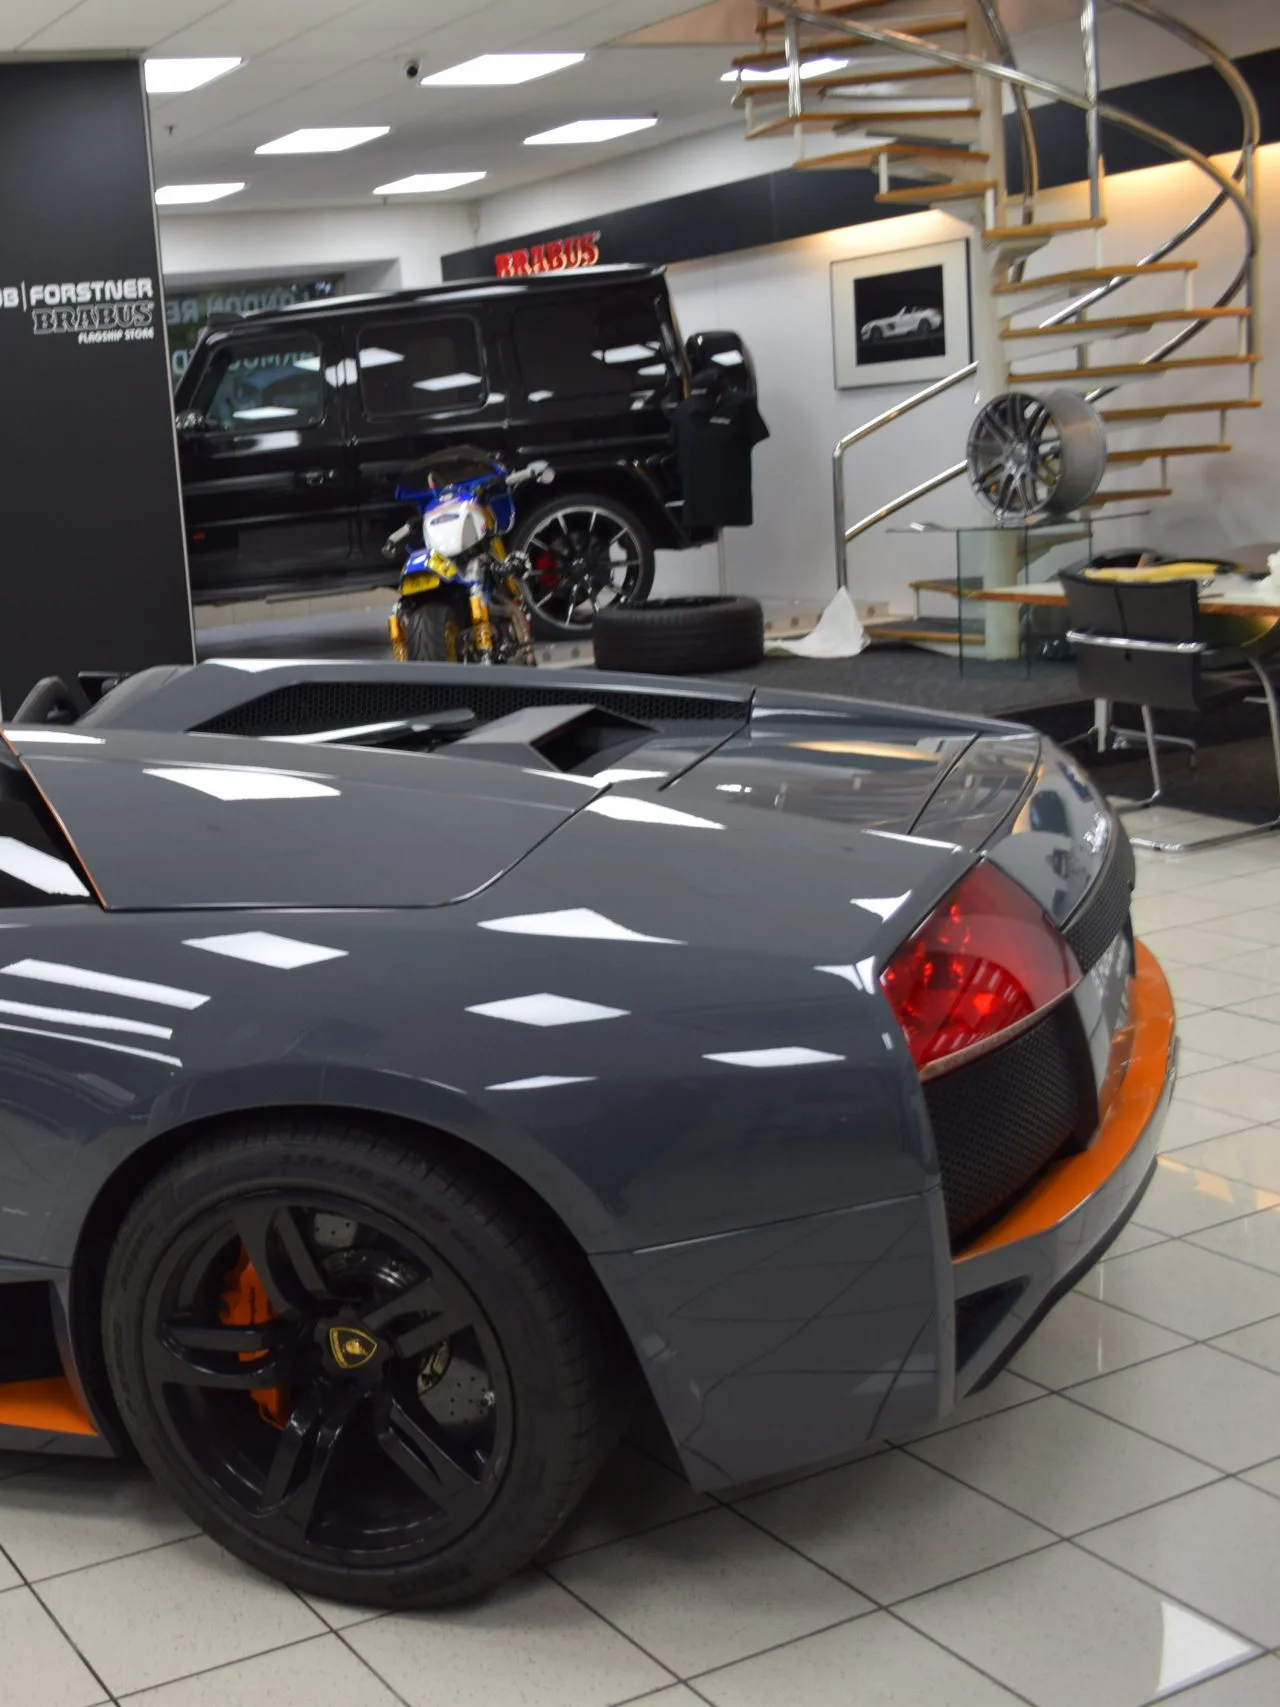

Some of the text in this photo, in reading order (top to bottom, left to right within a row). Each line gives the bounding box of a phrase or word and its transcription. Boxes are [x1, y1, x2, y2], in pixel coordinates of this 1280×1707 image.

[495, 231, 599, 278] BRABUS
[30, 277, 153, 306] FORSTNER
[33, 301, 154, 334] BRABUS
[78, 327, 154, 344] FLAGSHIP STORE
